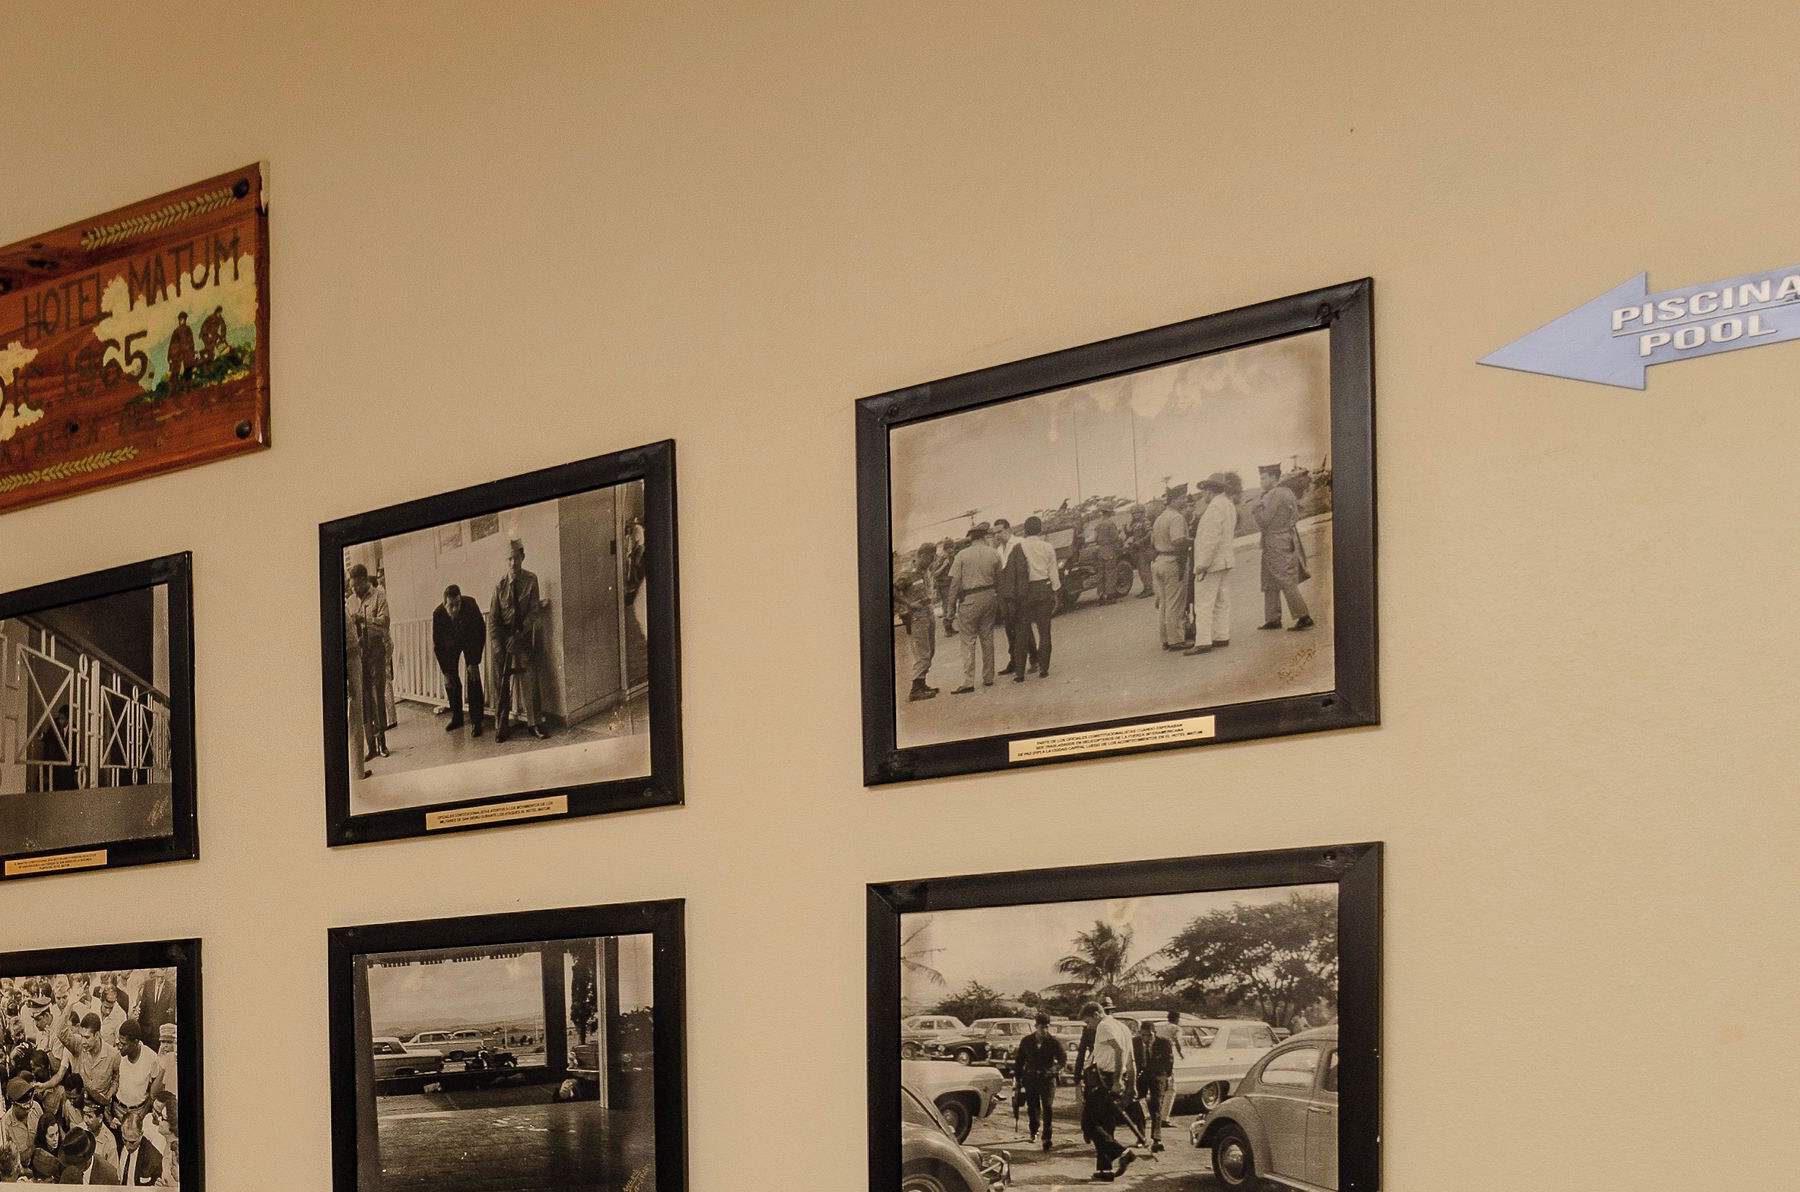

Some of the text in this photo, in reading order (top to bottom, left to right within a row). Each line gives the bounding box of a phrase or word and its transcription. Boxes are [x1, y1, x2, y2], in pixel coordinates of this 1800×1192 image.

[23, 273, 112, 345] HOTEL
[128, 228, 240, 312] MATUM
[1611, 274, 1800, 331] PISCINA
[1640, 314, 1778, 357] POOL
